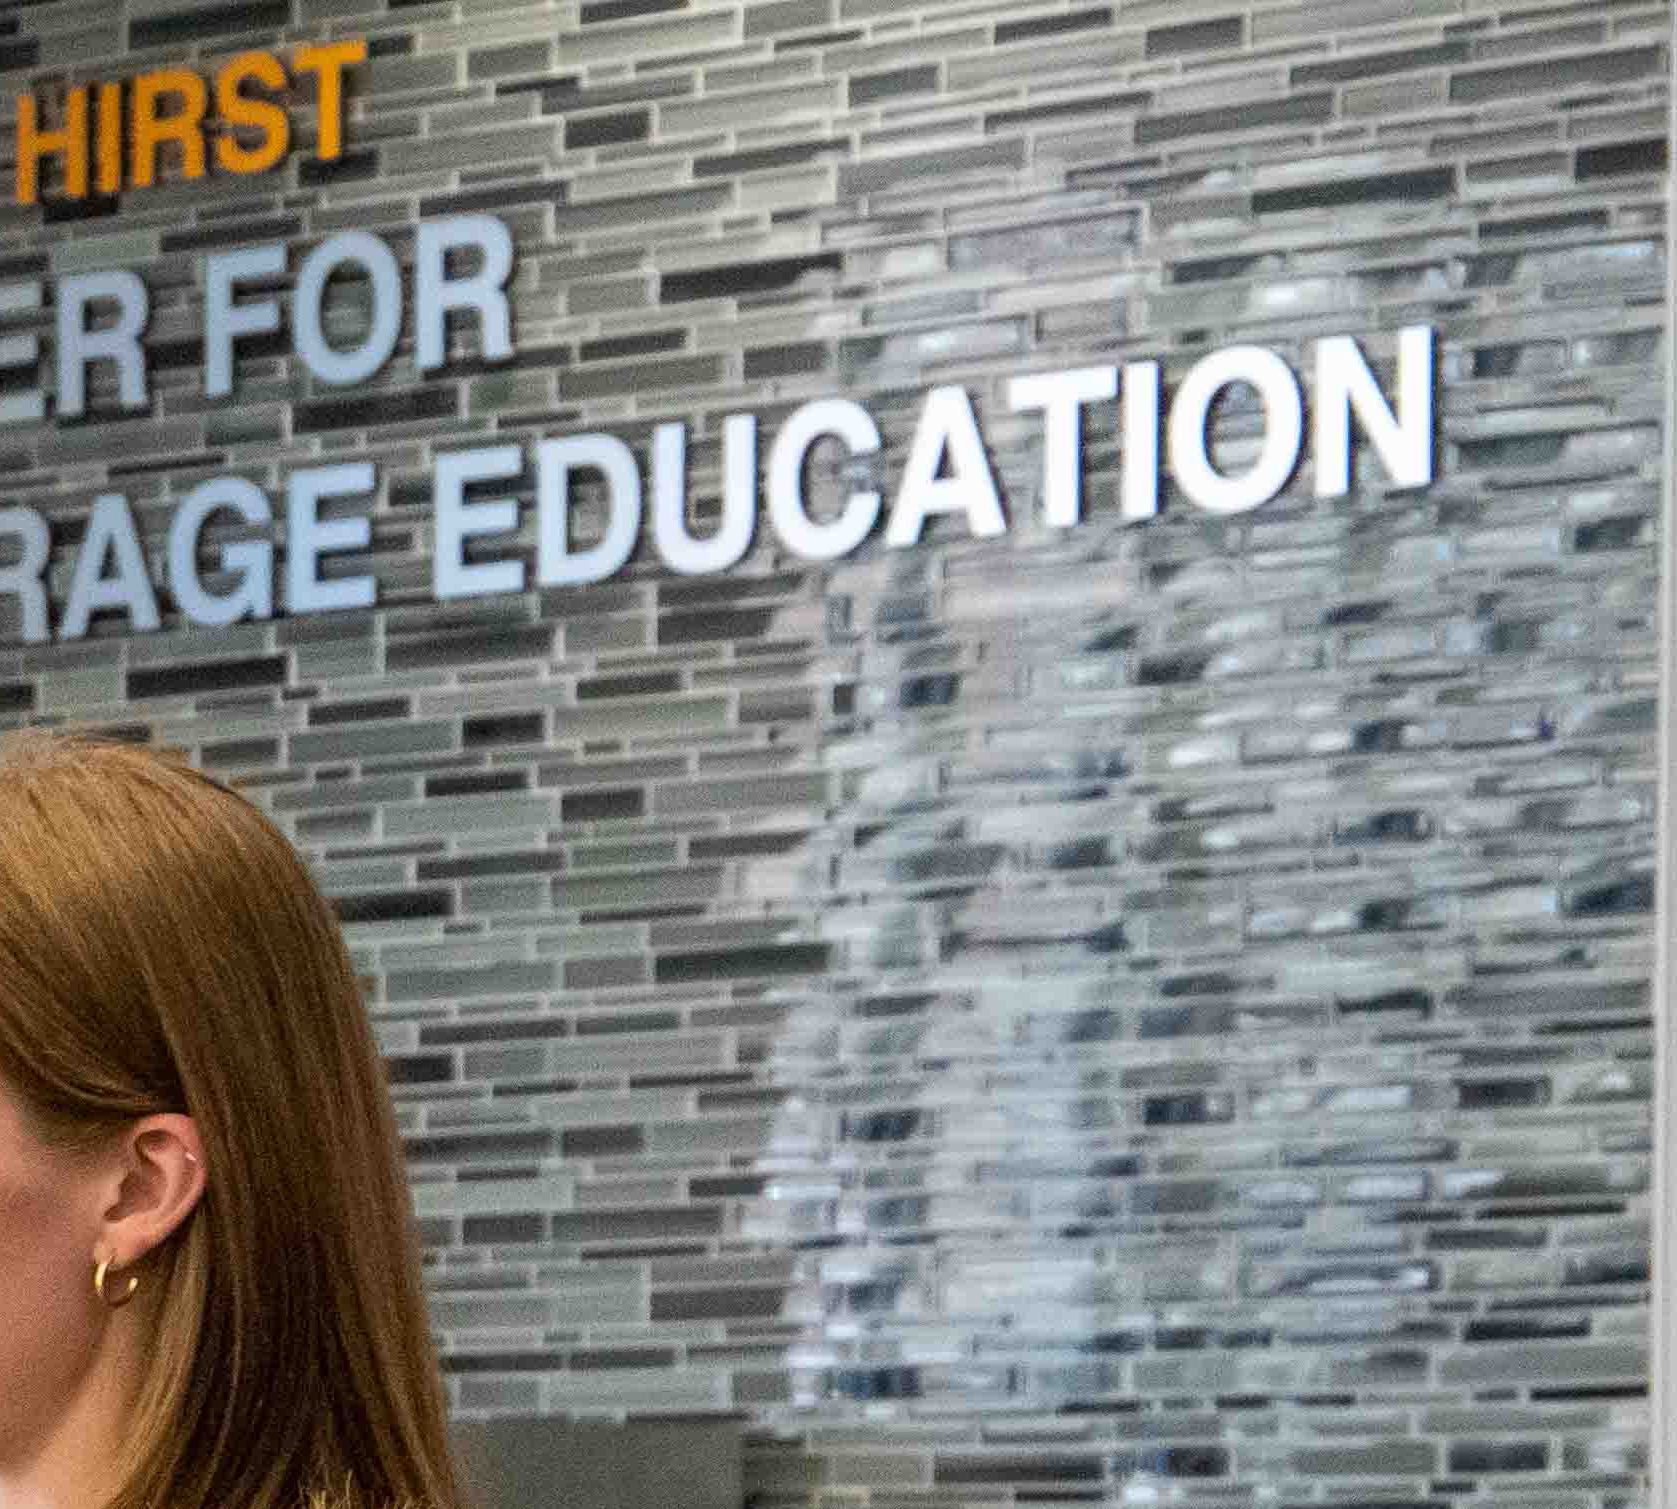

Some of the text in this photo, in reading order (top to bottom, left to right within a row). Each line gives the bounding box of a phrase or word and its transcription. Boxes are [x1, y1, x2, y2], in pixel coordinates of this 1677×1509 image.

[16, 39, 367, 204] HIRST
[203, 214, 515, 398] FOR
[432, 323, 1440, 601] EDUCATION
